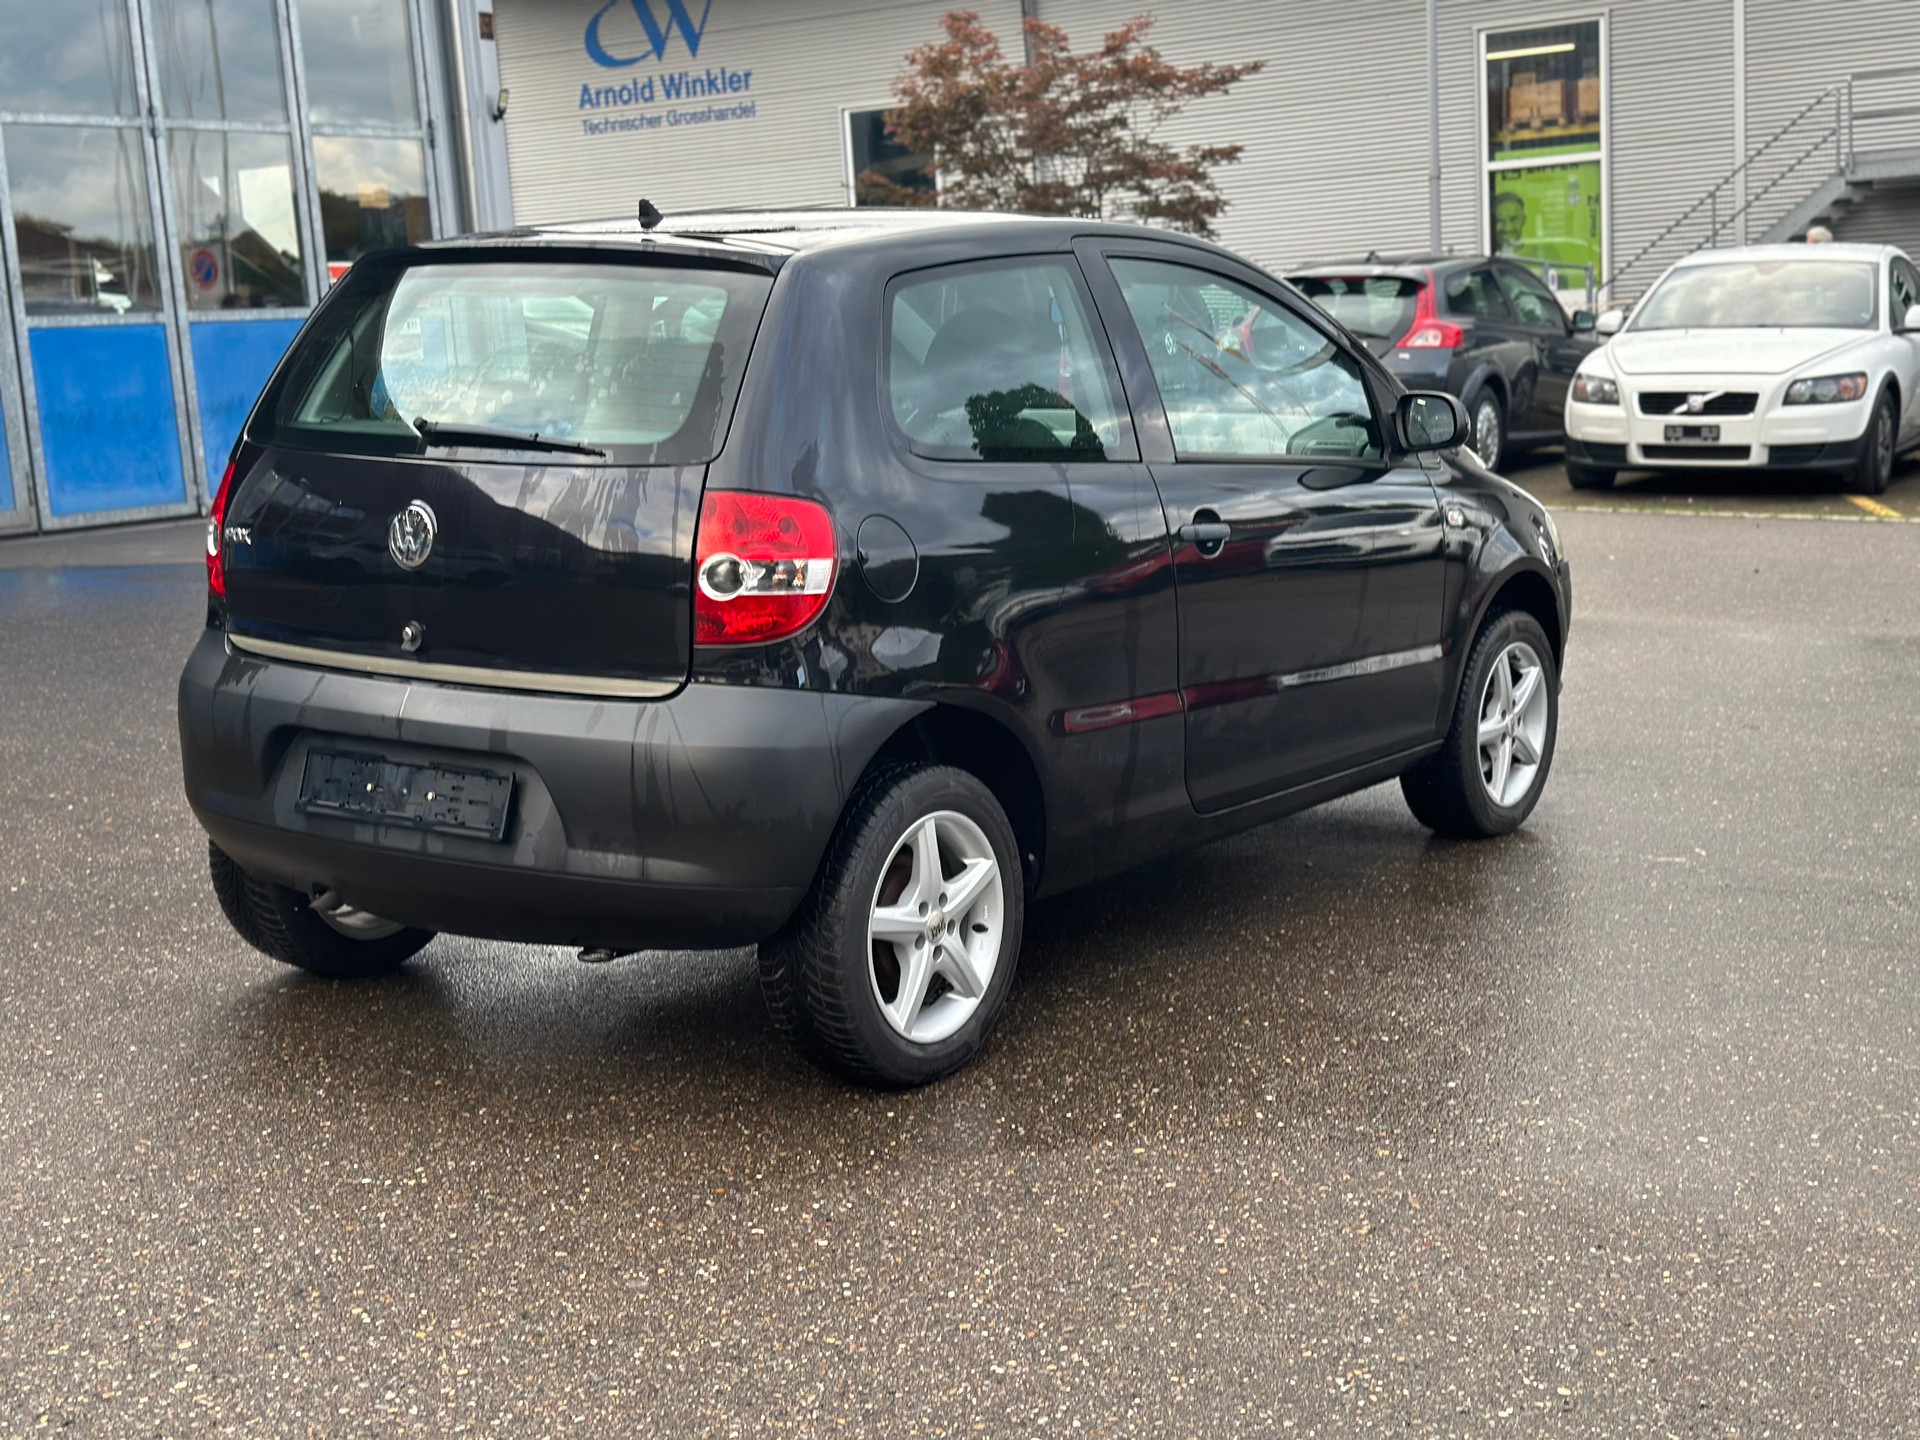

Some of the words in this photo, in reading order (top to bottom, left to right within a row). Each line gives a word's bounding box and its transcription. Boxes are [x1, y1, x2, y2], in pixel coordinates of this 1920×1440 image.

[579, 76, 655, 110] Arnold
[660, 67, 752, 101] Winkler
[582, 113, 663, 135] Technischer
[666, 101, 757, 127] Grosshandel
